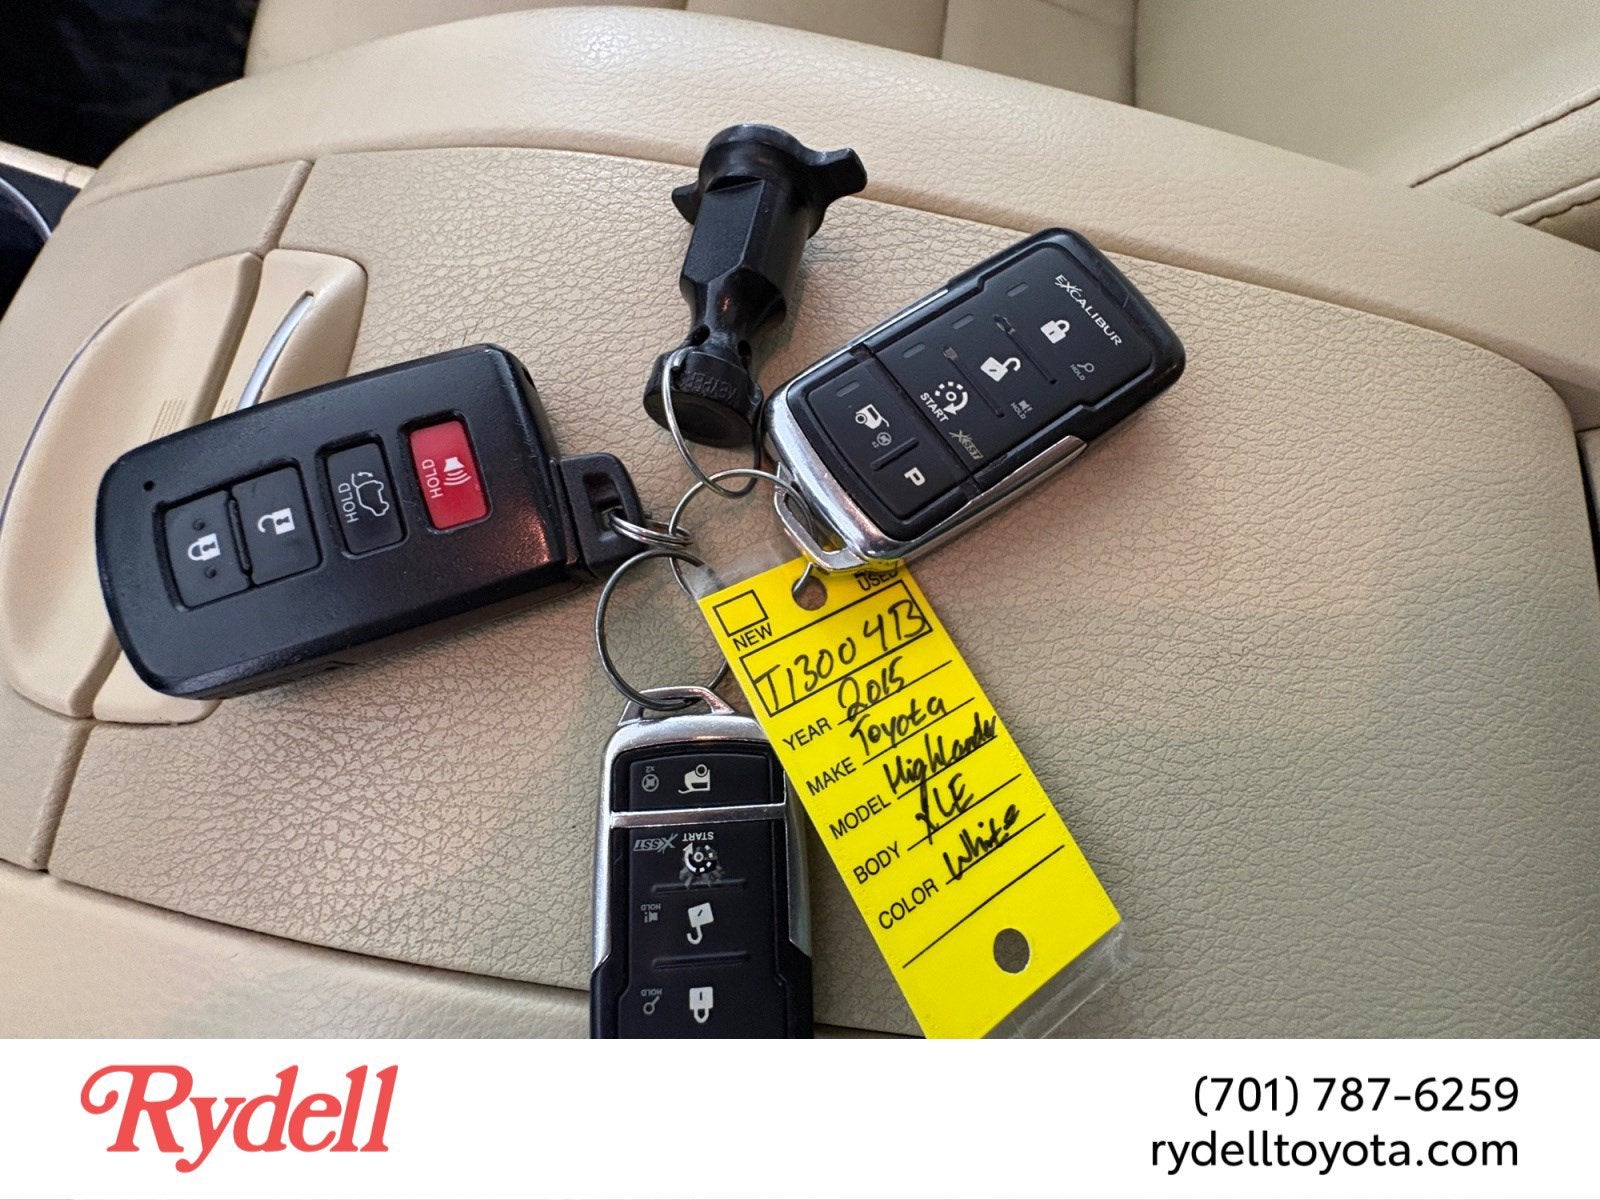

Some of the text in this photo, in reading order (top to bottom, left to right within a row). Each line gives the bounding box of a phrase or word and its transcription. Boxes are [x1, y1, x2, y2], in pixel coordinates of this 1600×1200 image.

[1054, 274, 1123, 346] EXCALIBUR
[1070, 363, 1086, 381] HOLD
[920, 392, 949, 422] START
[421, 459, 443, 498] HOLD
[338, 482, 359, 523] HOLD
[732, 622, 773, 651] NEW
[838, 656, 905, 722] 2015
[782, 717, 832, 752] YEAR
[850, 695, 947, 756] Toyota
[806, 756, 858, 796] MAKE
[829, 794, 891, 840] MODEL
[915, 773, 974, 845] XLE
[682, 831, 714, 842] START
[943, 804, 1020, 880] White
[853, 841, 900, 884] BODY
[640, 903, 661, 911] HOLD
[878, 878, 939, 930] COLOR
[641, 988, 662, 996] HOLD
